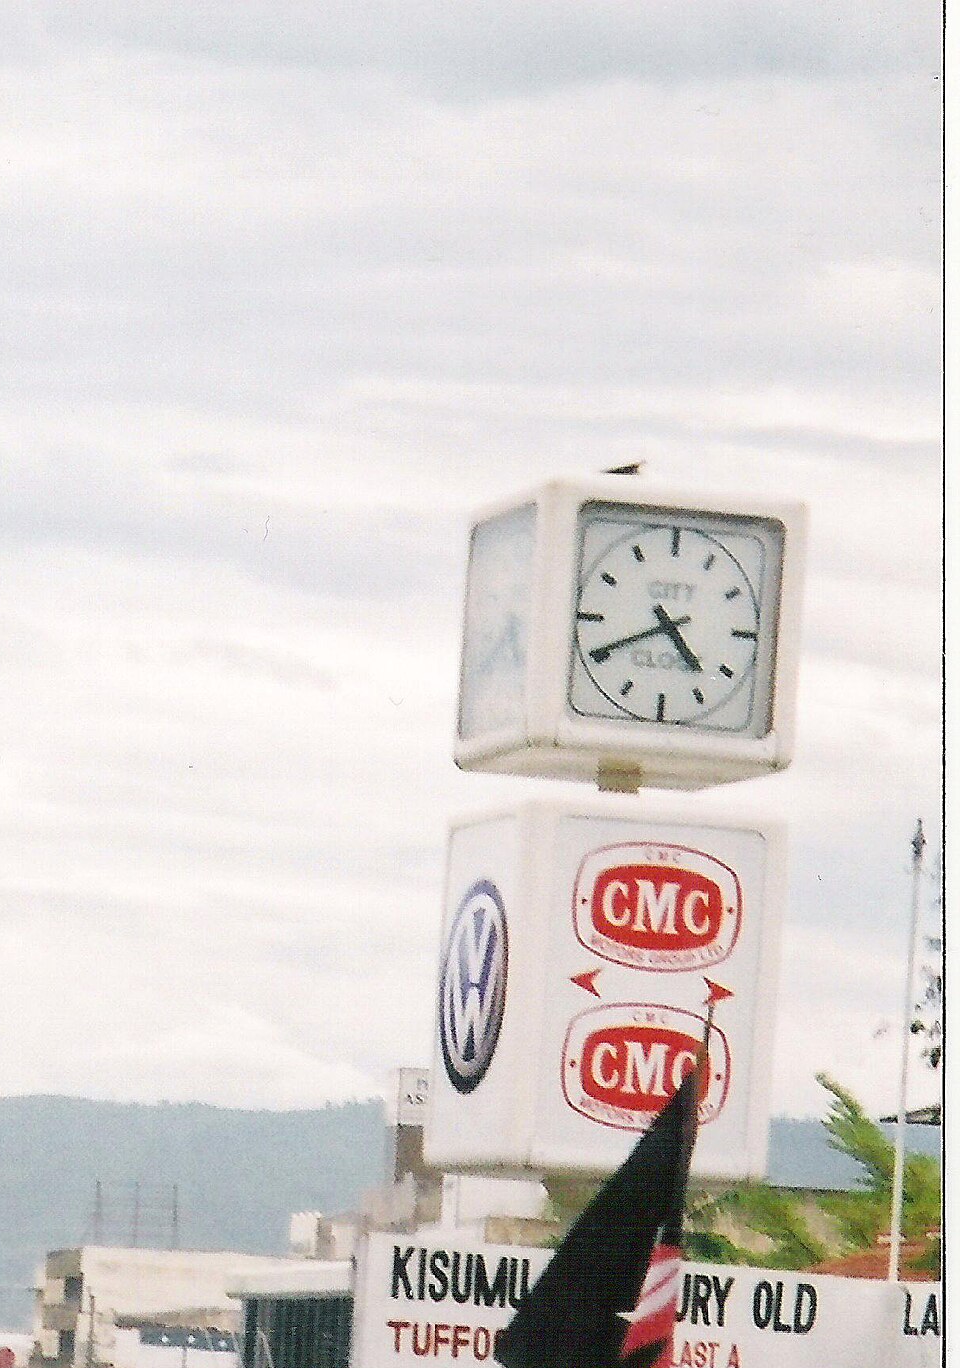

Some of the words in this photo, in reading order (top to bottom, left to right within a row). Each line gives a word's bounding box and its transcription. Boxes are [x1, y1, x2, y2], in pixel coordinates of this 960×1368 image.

[648, 580, 696, 601] CITY
[630, 648, 688, 671] CLO
[602, 879, 711, 936] CMC
[591, 1041, 697, 1097] CMC
[391, 1245, 531, 1309] KISUMU
[752, 1281, 818, 1335] OLD
